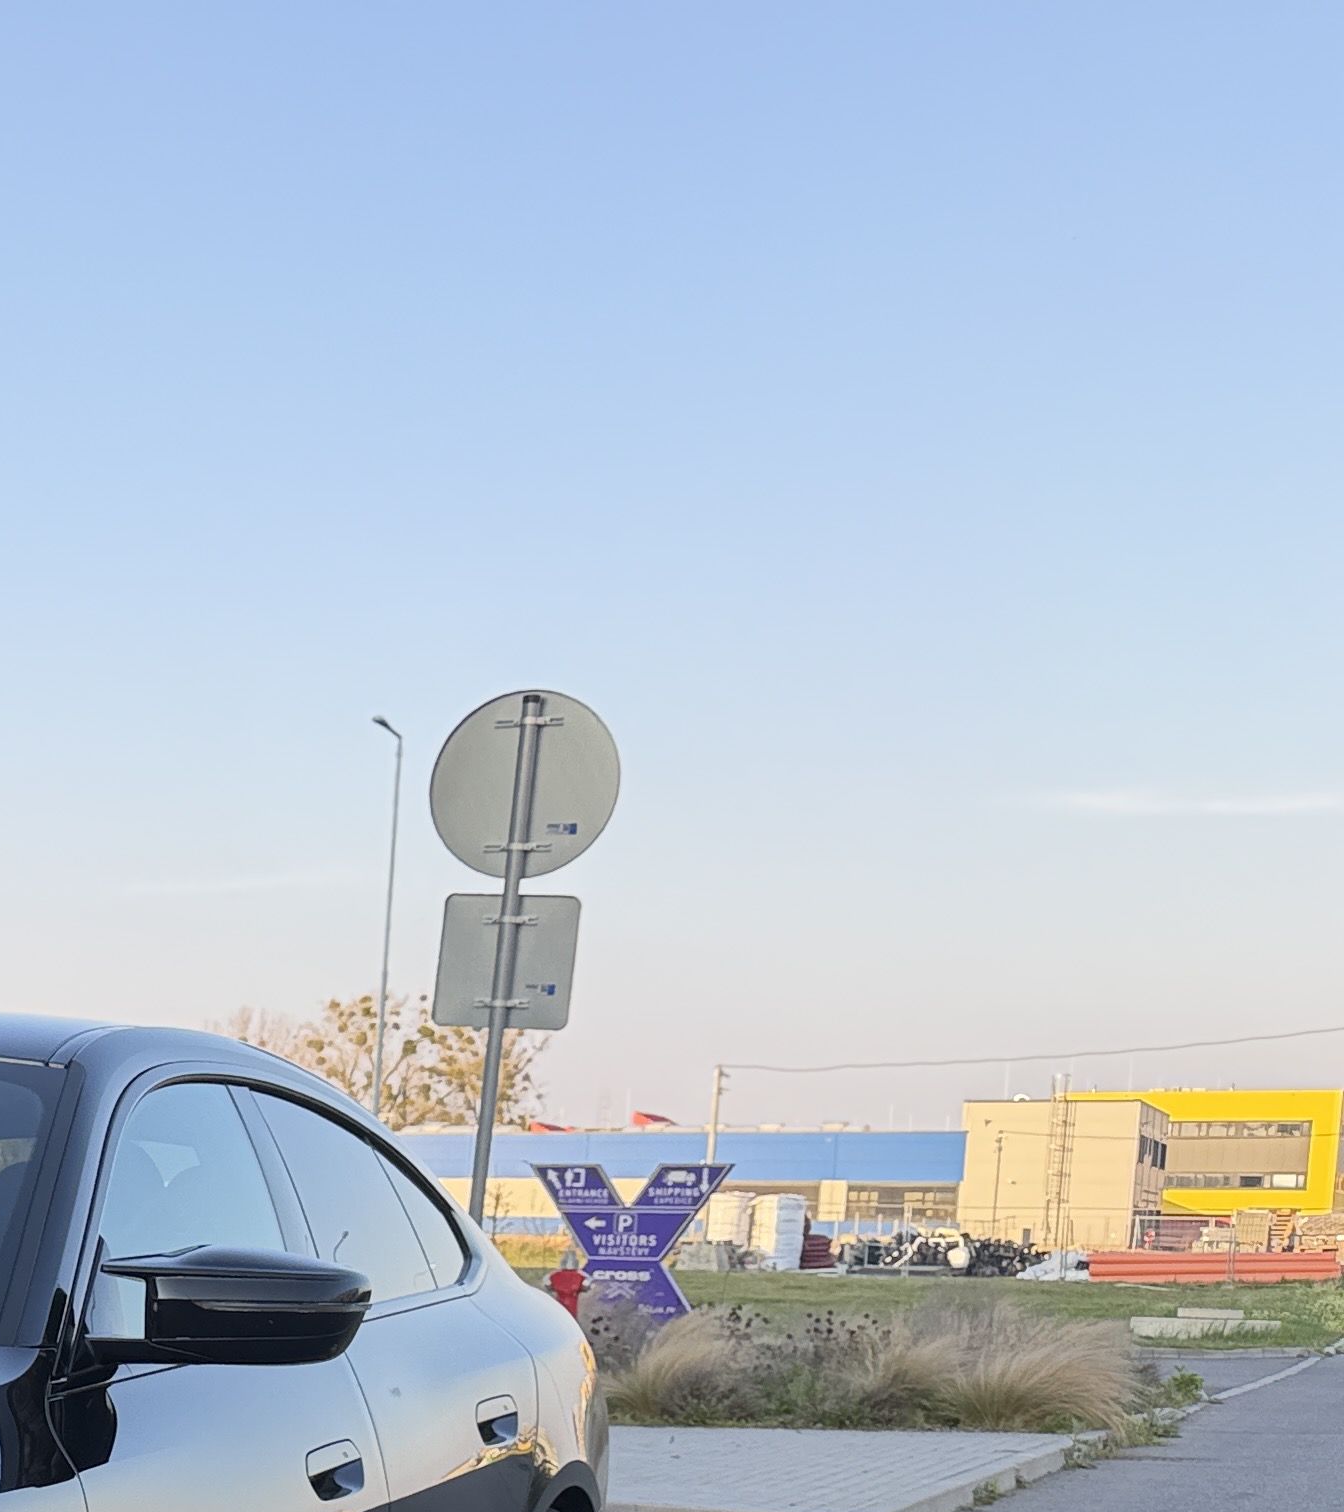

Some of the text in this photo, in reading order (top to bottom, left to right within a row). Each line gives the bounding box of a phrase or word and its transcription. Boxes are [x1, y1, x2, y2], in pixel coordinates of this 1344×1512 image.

[557, 1188, 609, 1199] ENTRANCE
[647, 1187, 700, 1198] SHIPPING
[592, 1234, 658, 1247] VISITORS
